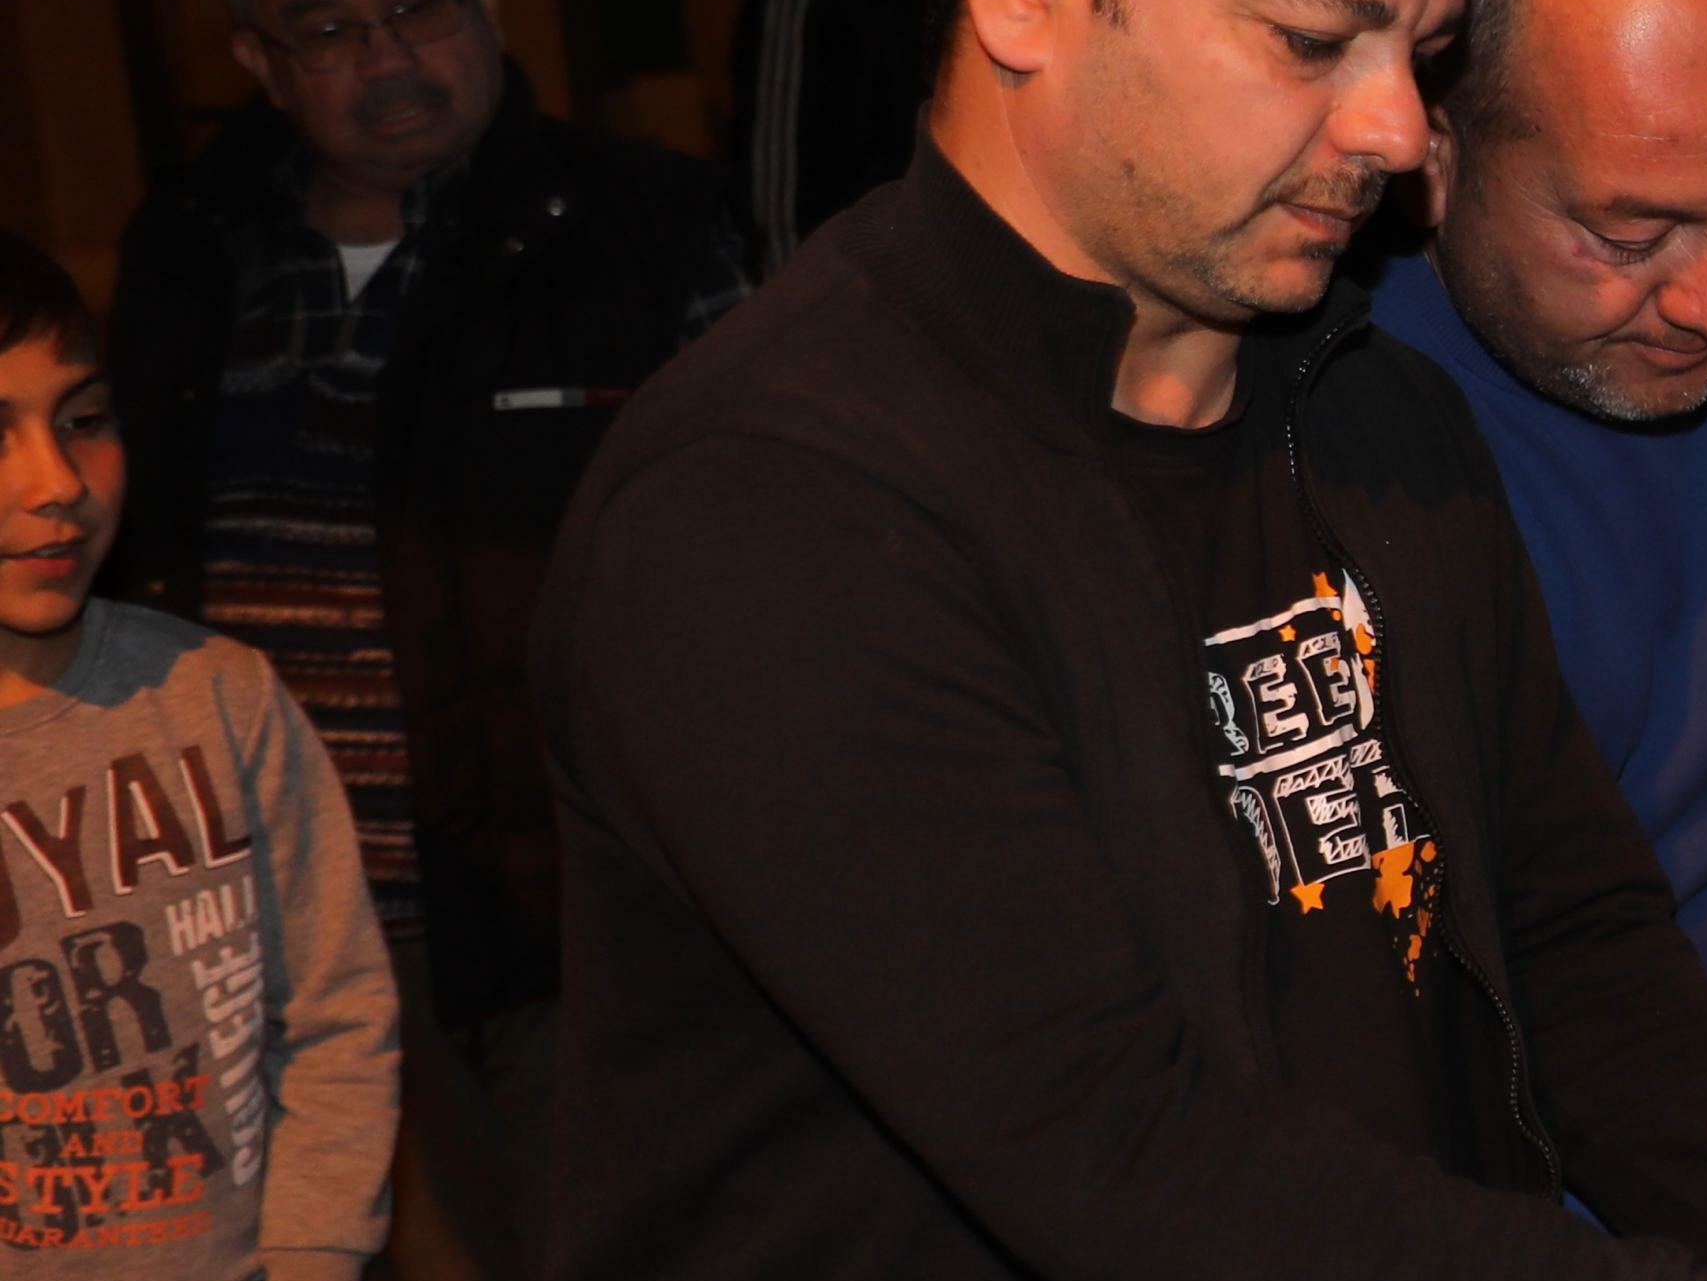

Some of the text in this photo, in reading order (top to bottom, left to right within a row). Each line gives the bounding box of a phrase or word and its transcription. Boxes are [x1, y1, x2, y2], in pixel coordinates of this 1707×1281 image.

[0, 744, 253, 952] YAL
[0, 1074, 213, 1125] COMFORT
[60, 1130, 145, 1159] AND
[0, 1152, 207, 1215] STYLE
